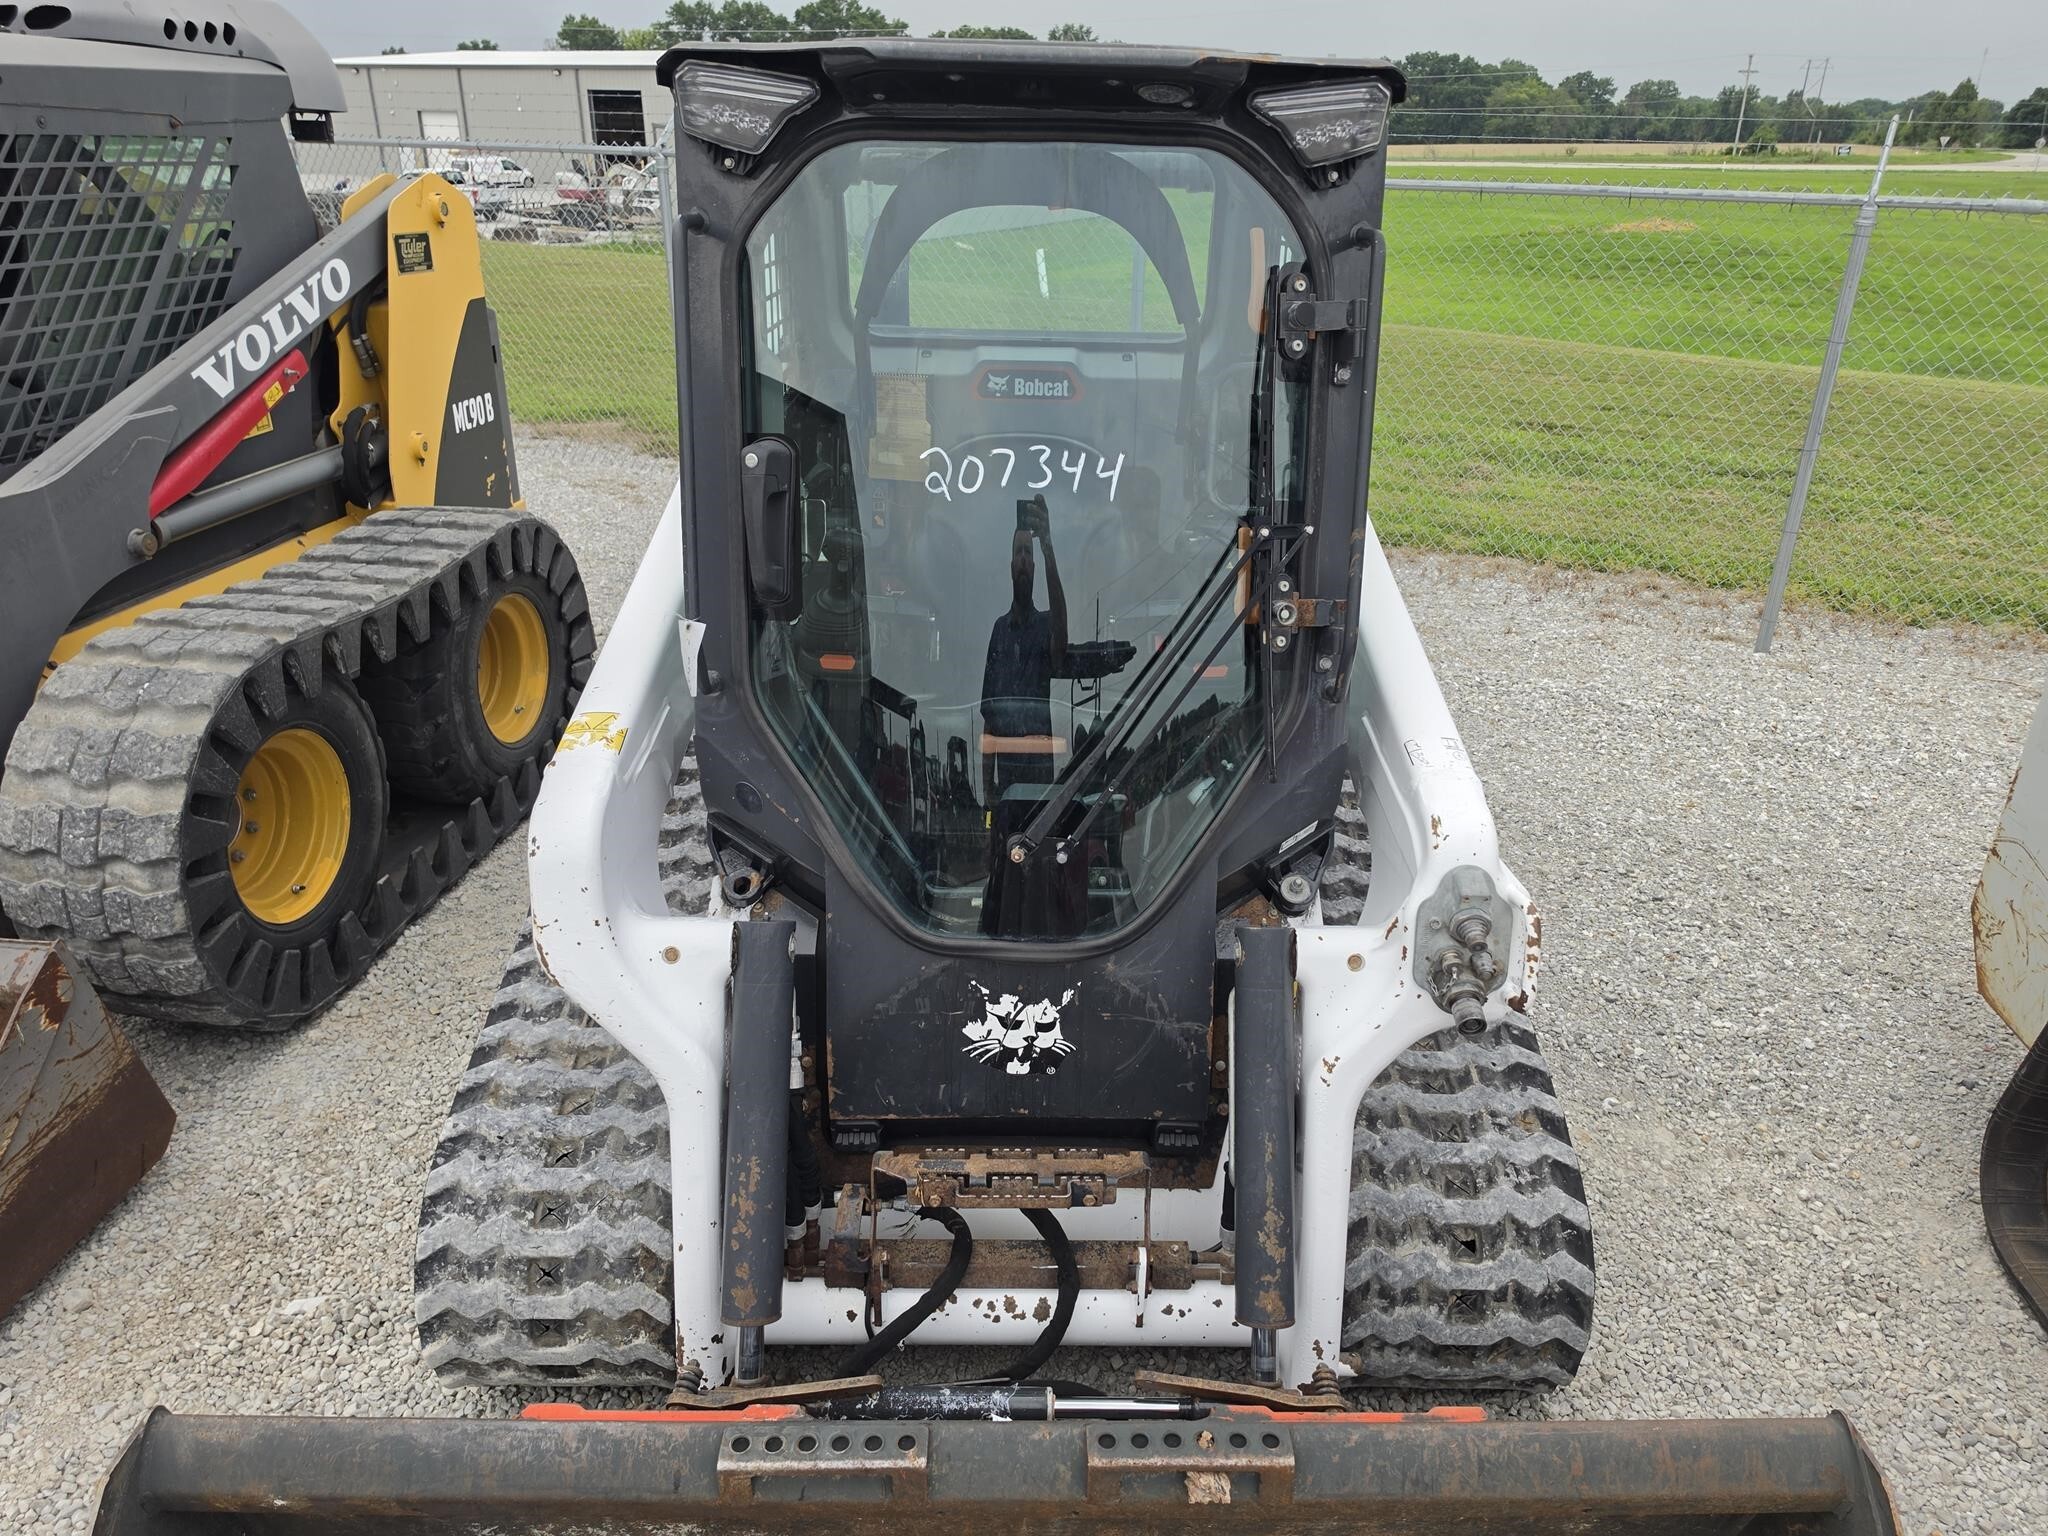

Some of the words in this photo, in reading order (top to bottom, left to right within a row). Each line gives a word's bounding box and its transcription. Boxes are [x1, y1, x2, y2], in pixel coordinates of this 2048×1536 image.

[399, 238, 426, 258] Tyler
[190, 258, 351, 398] VOLVO
[1014, 378, 1069, 397] Bobcat
[452, 395, 486, 434] MC90
[484, 392, 495, 422] B
[919, 444, 1125, 502] 207344
